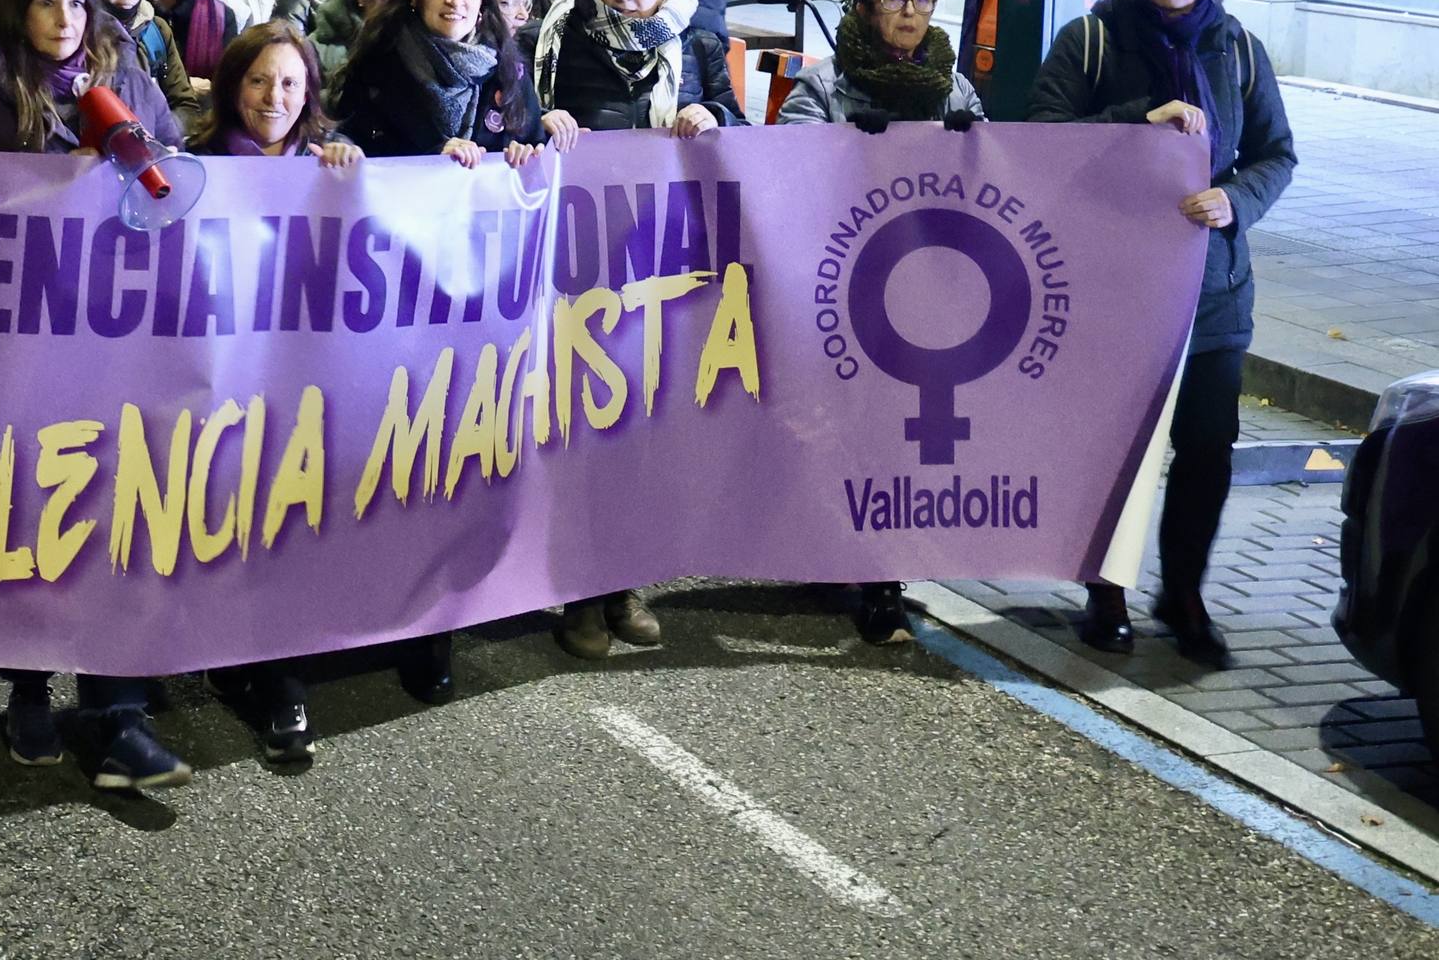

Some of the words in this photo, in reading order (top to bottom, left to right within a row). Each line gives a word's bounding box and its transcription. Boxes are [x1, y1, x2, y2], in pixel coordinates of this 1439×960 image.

[253, 180, 754, 334] INSTITUONAL
[815, 172, 966, 381] COORDINADORA
[976, 183, 1026, 224] DE
[1018, 221, 1070, 381] MUJERES
[353, 262, 761, 521] MACHISTA
[844, 475, 1039, 532] Valladolid
